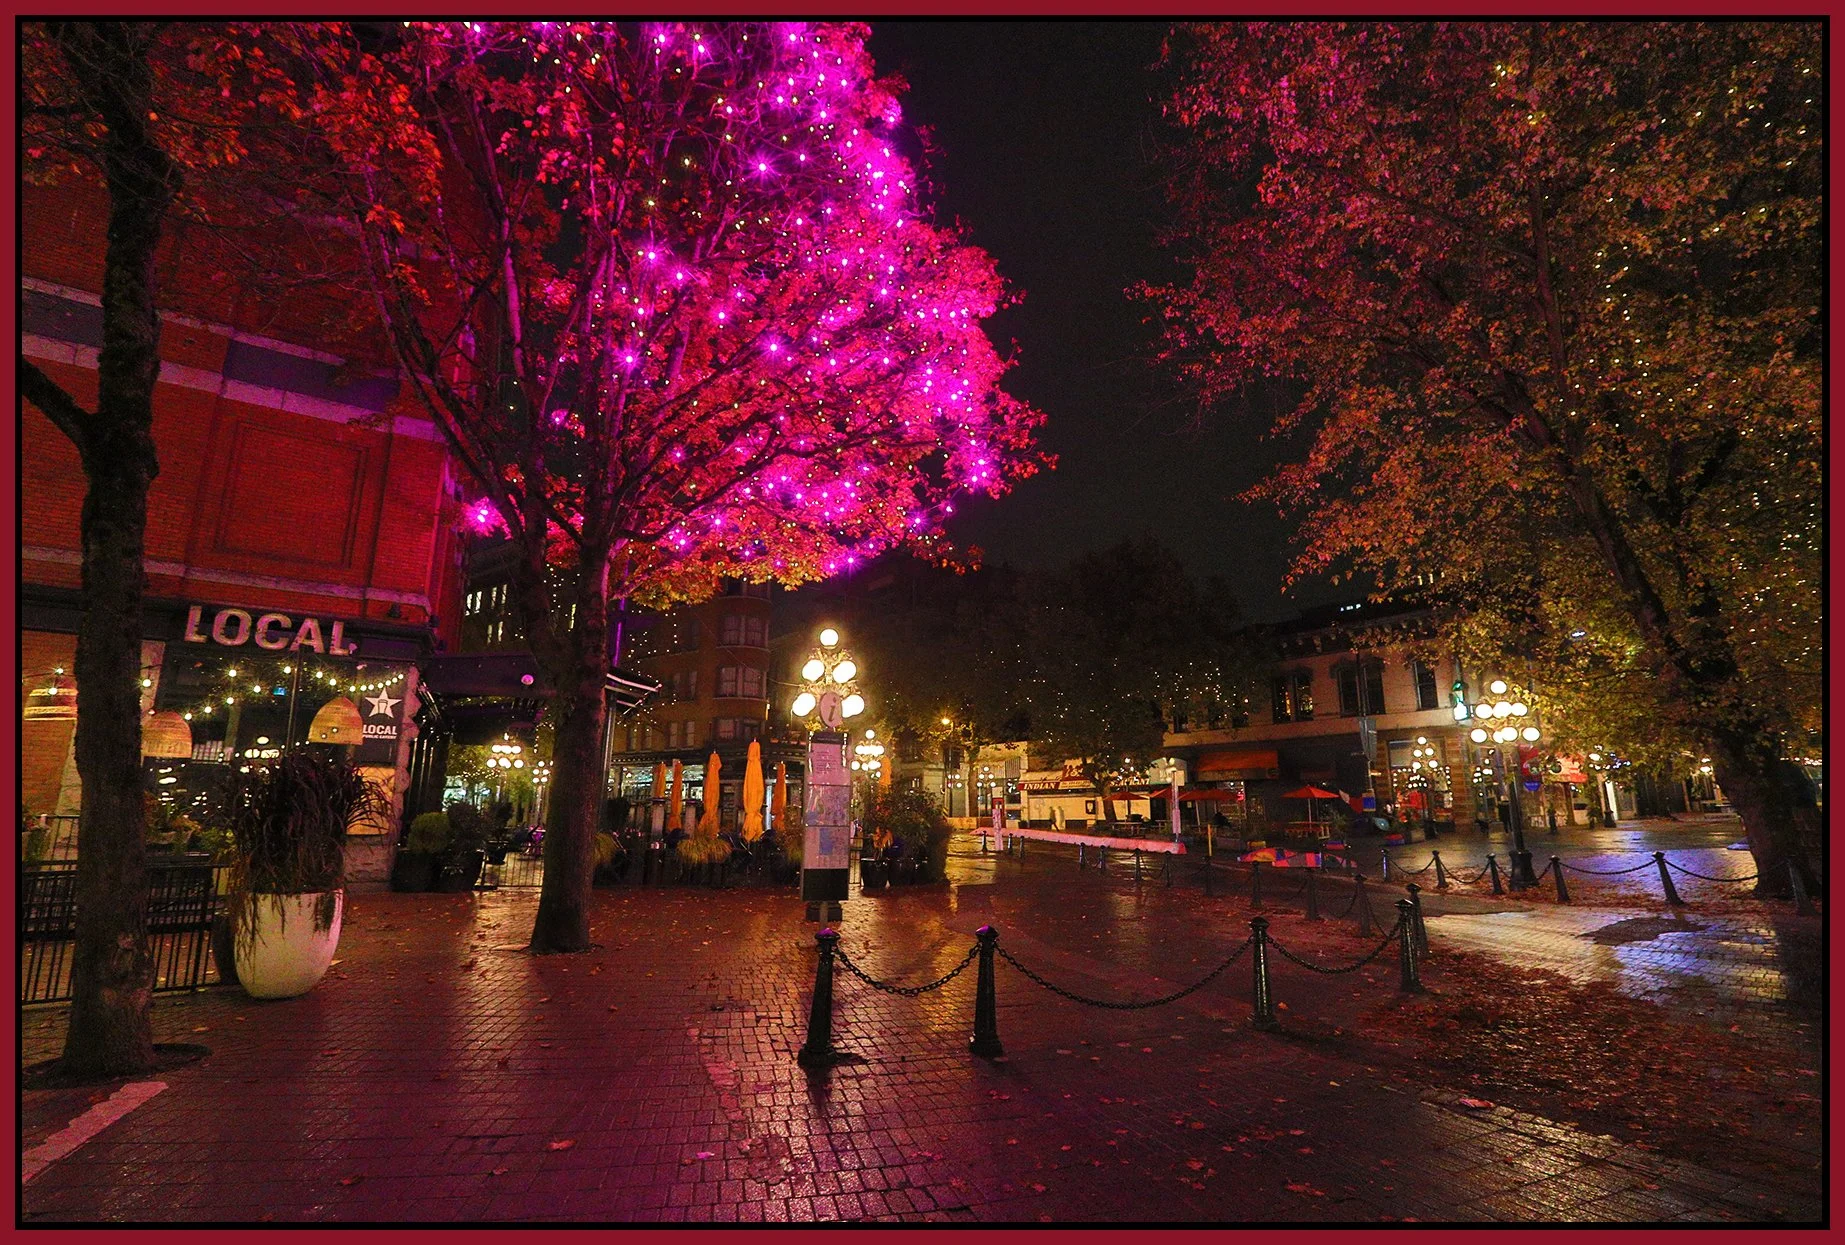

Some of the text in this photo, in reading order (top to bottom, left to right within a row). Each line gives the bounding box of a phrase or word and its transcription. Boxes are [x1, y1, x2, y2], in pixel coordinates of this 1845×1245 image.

[183, 605, 352, 656] LOCAL
[363, 724, 398, 736] LOCAL
[1023, 782, 1056, 790] INDIAN
